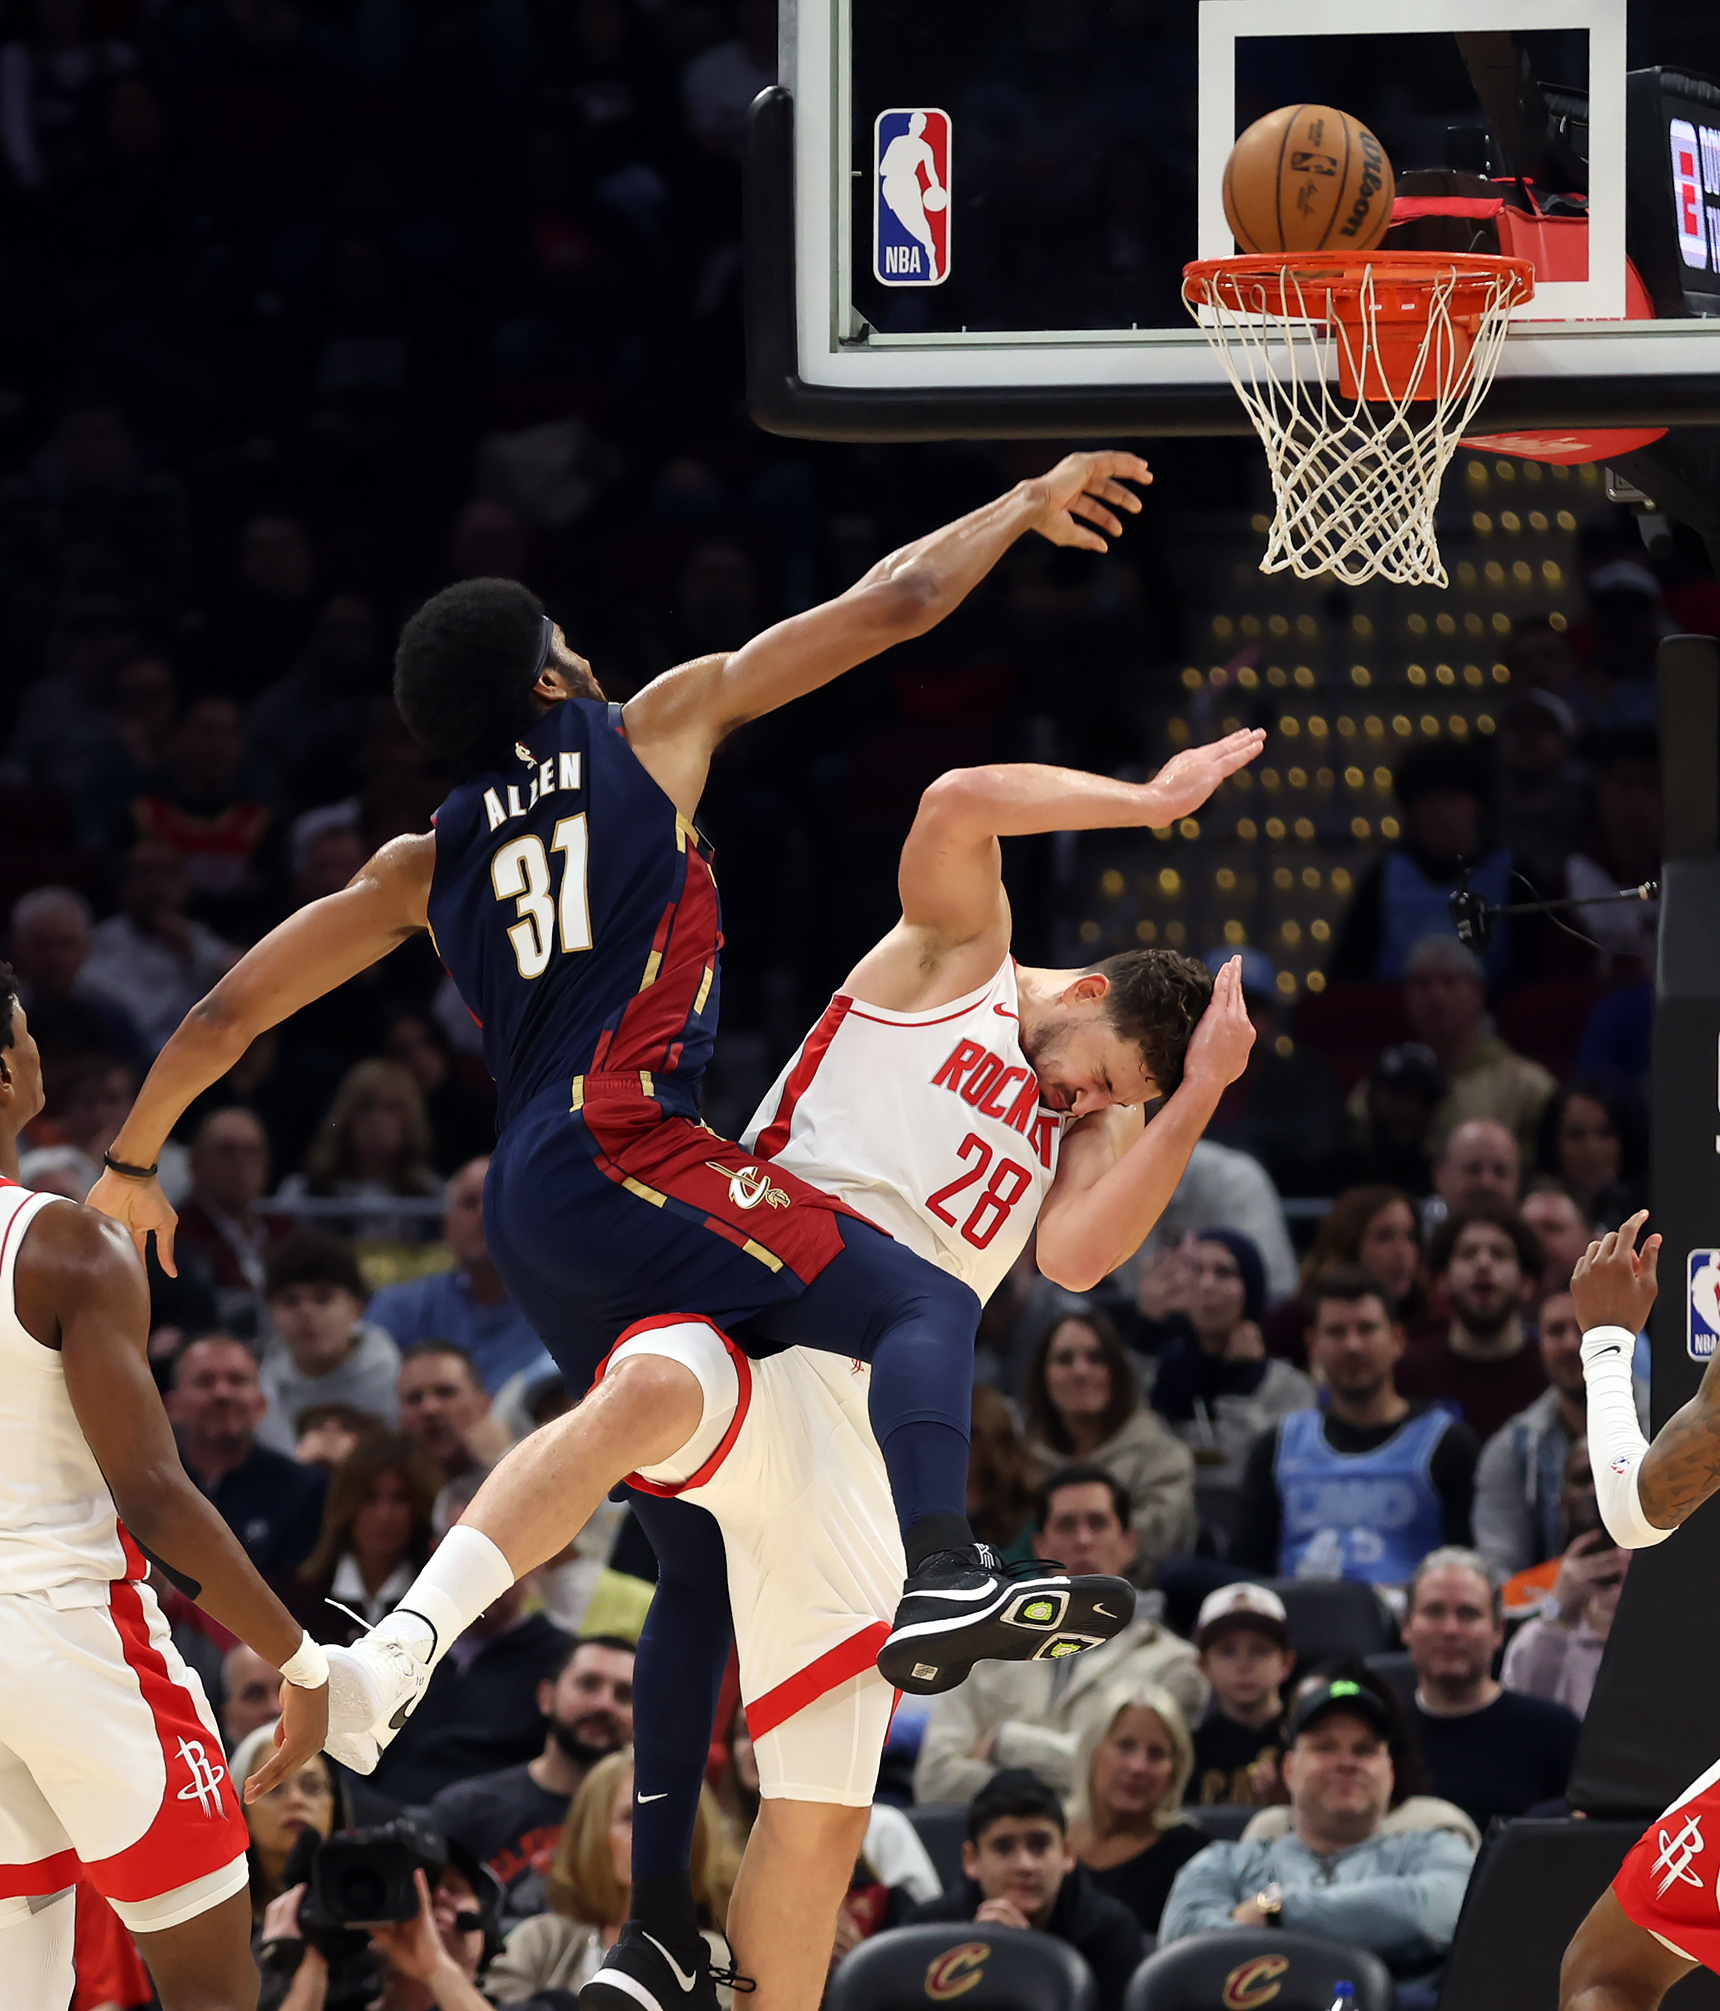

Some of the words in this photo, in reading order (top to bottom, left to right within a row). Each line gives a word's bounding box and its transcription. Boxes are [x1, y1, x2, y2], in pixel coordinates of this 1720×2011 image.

[885, 245, 922, 274] NBA
[490, 810, 593, 980] 31
[925, 1132, 1032, 1250] 28
